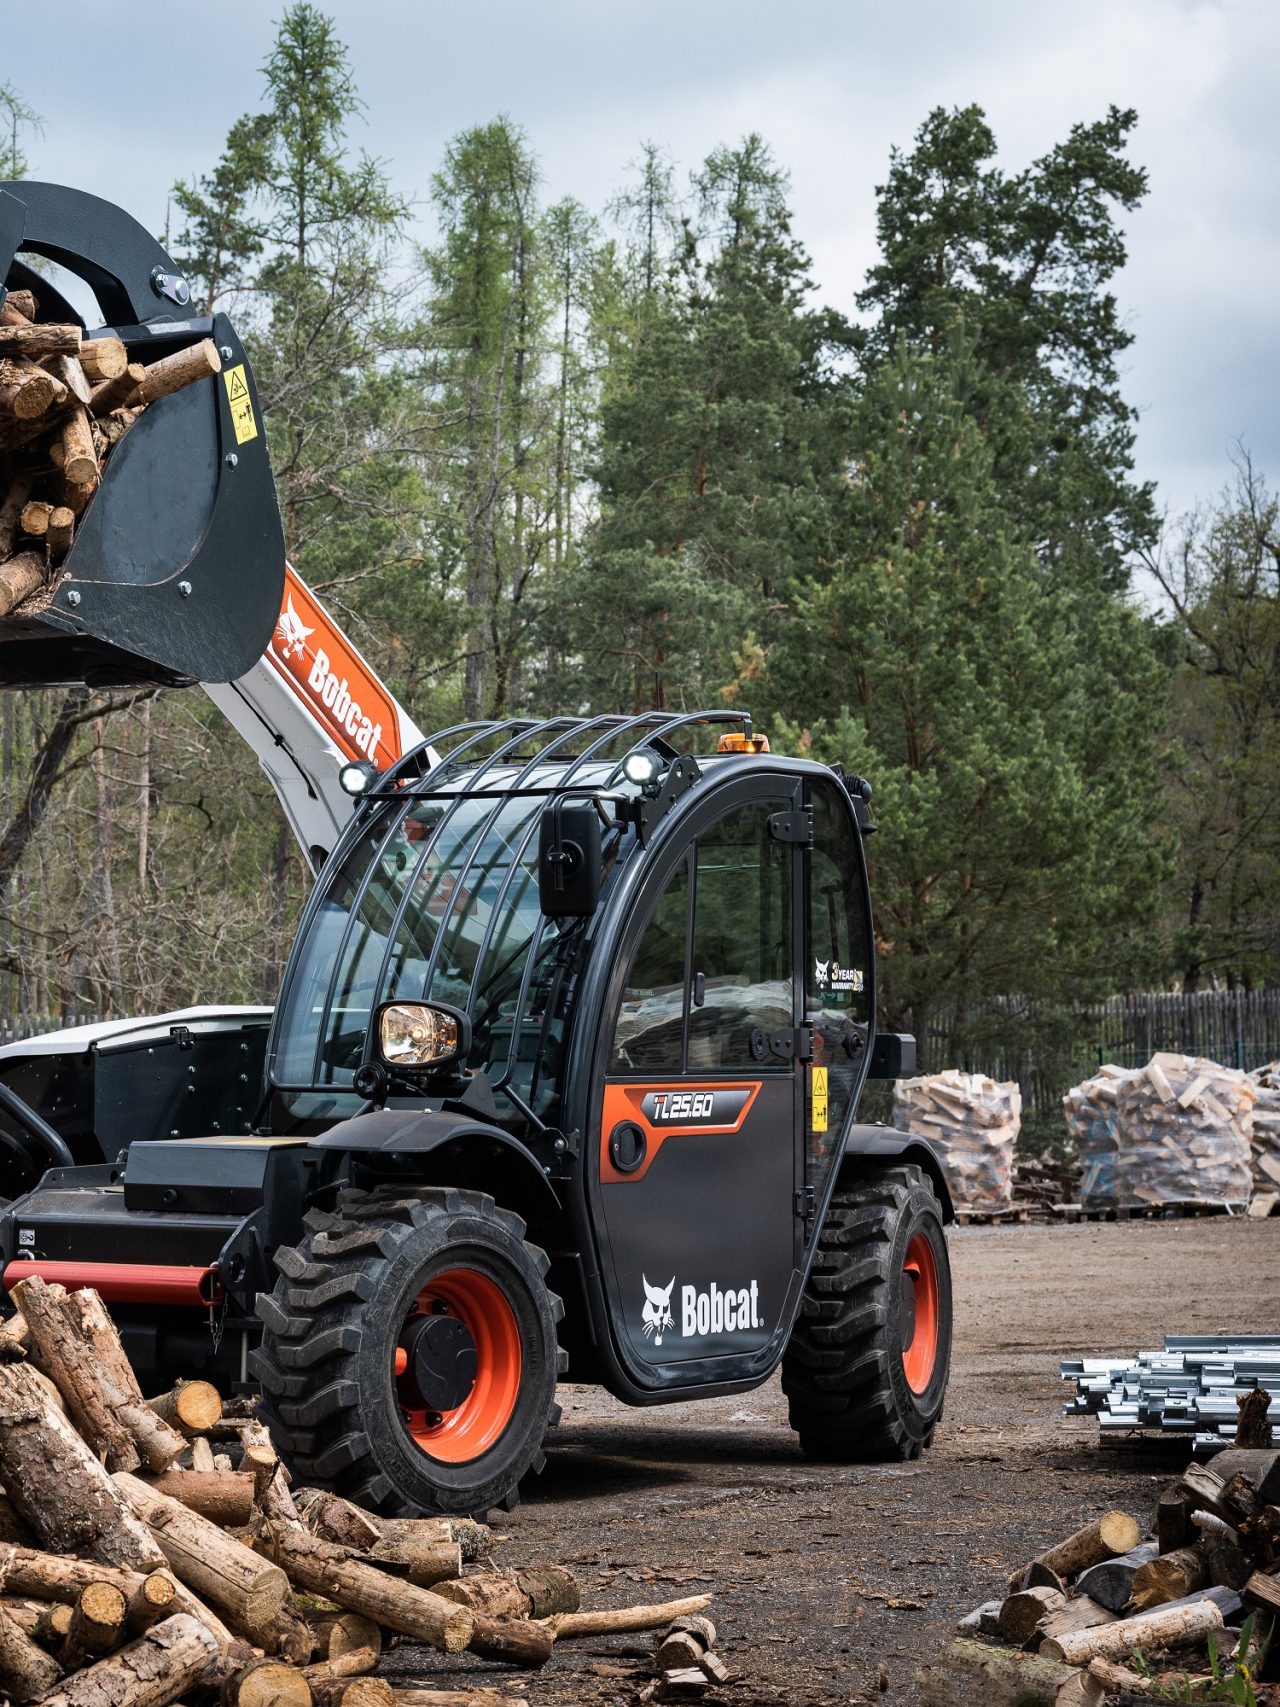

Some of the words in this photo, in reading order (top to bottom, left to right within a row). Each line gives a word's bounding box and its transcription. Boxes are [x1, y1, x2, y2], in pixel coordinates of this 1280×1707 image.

[308, 648, 382, 762] Bobcat
[831, 962, 839, 981] 3
[838, 969, 854, 980] YEAR
[682, 1280, 759, 1337] Bobcat
